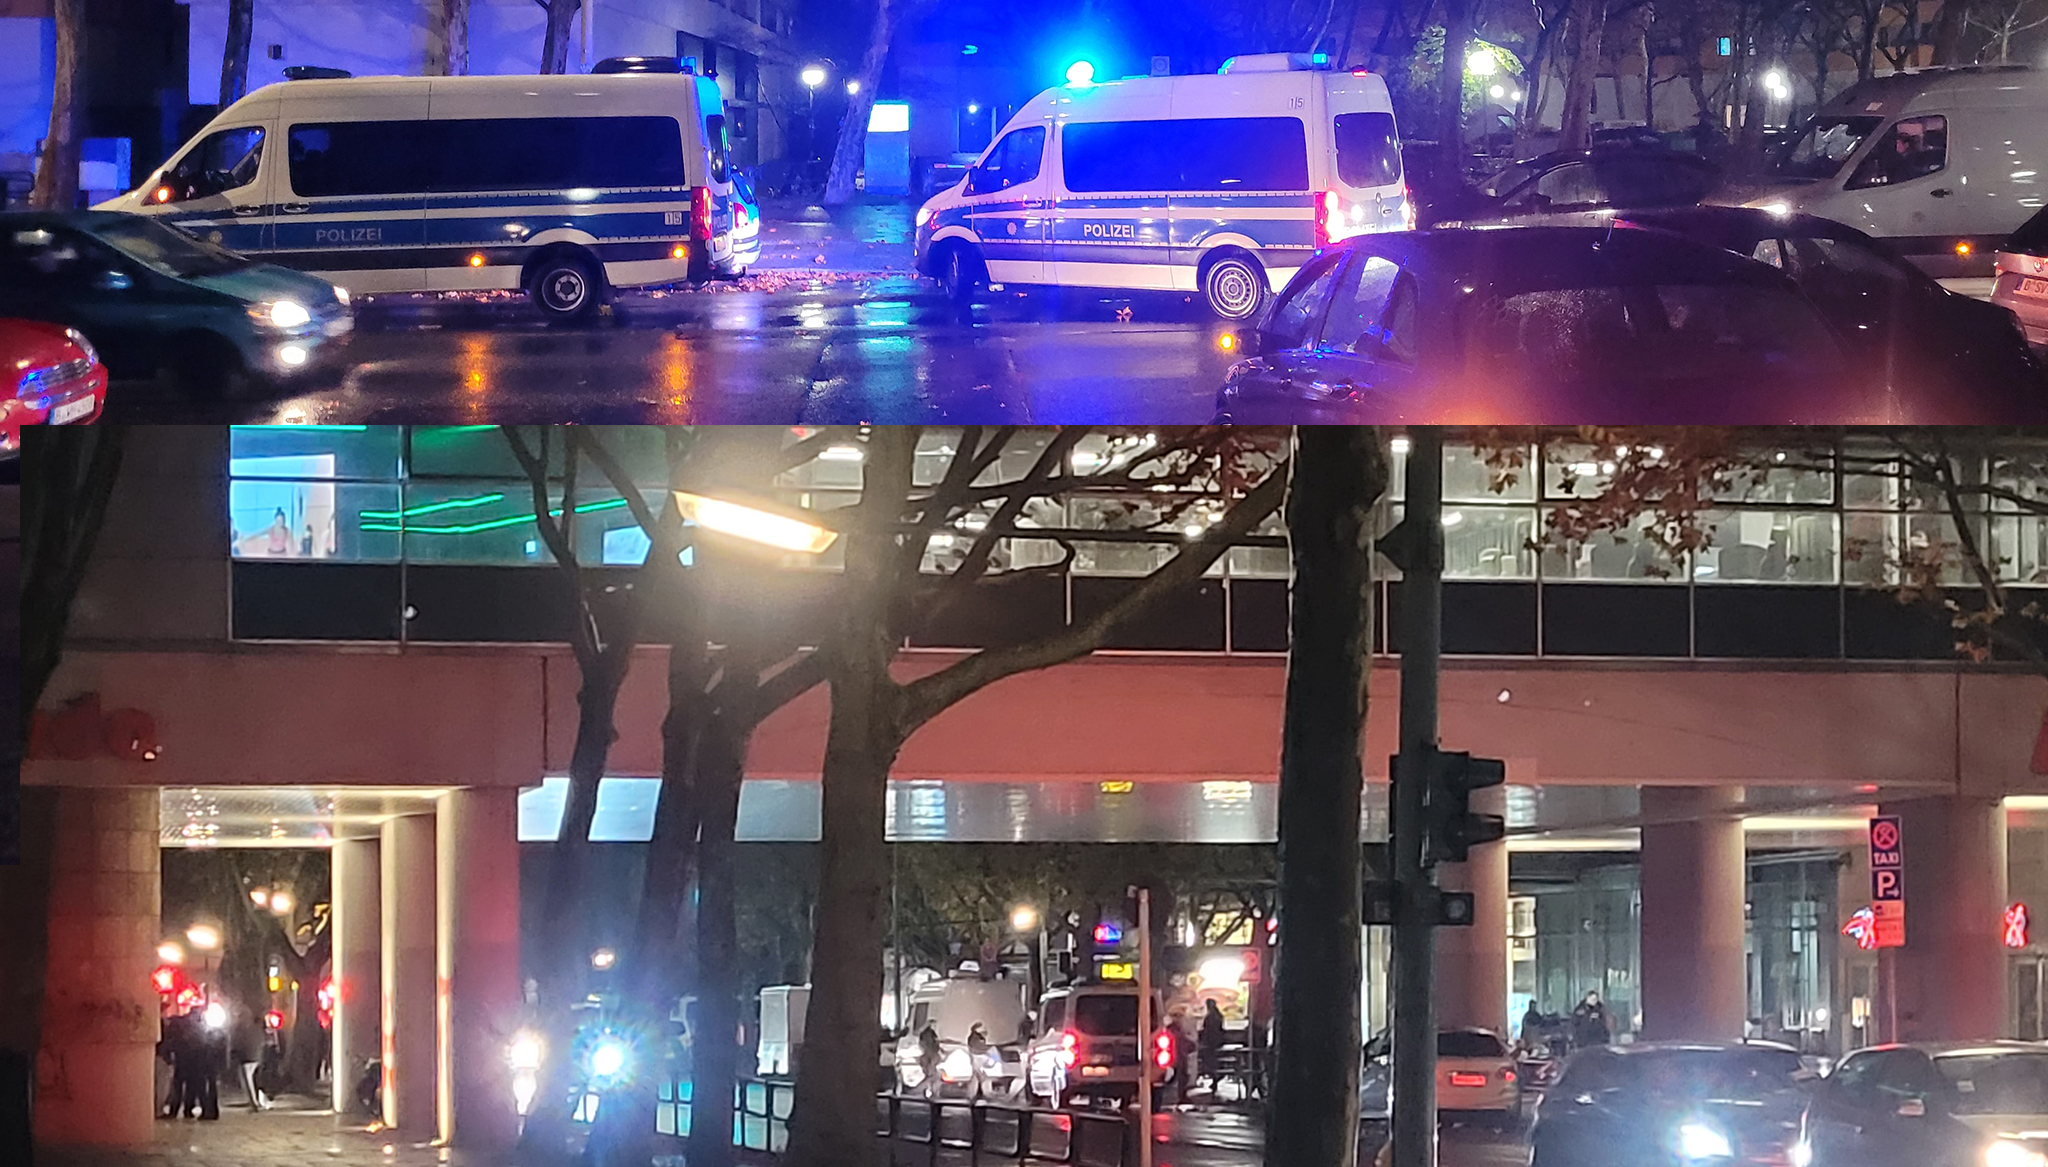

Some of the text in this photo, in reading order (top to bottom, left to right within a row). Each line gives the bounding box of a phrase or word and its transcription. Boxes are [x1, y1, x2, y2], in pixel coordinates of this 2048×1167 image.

[316, 228, 382, 242] POLIZEI
[1083, 223, 1135, 238] POLIZEI
[1873, 852, 1899, 865] TAXI
[1877, 871, 1895, 898] P
